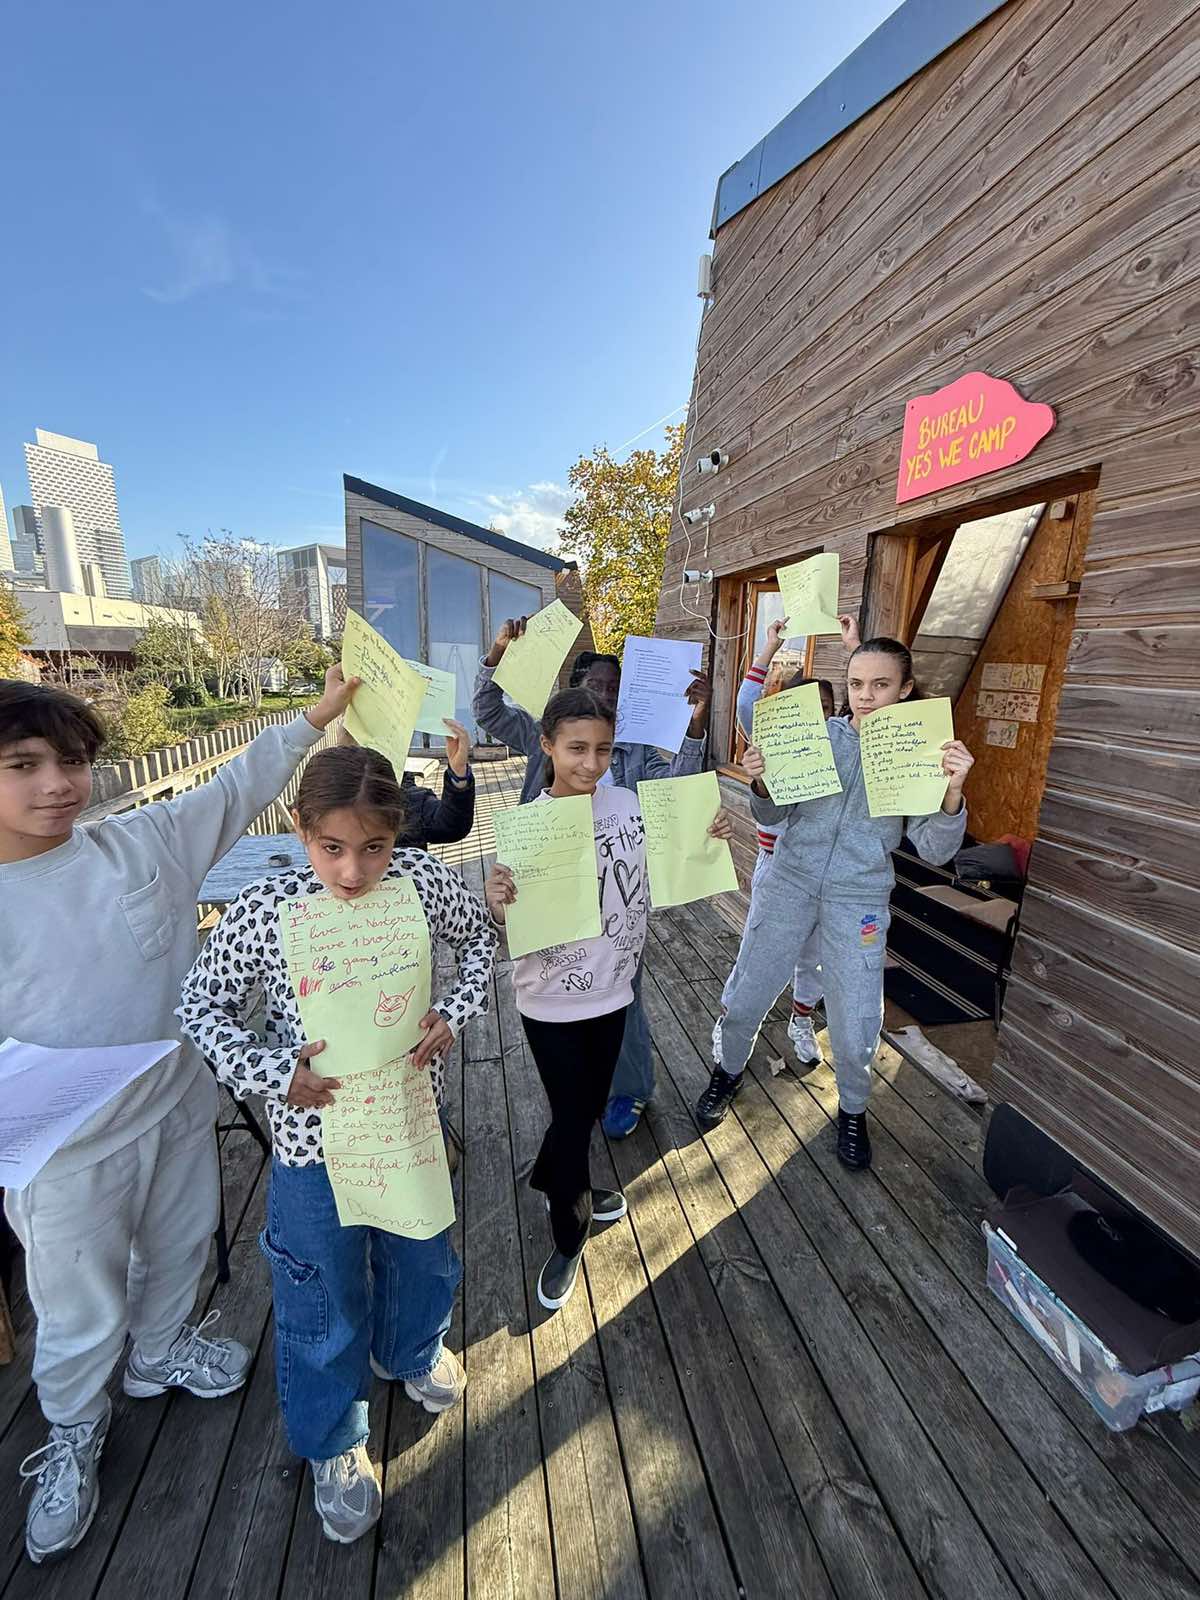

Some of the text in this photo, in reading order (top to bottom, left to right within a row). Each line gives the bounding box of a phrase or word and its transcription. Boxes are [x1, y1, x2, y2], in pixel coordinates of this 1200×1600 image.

[906, 416, 1017, 487] YES WE CAMP
[918, 393, 984, 450] BUREAU
